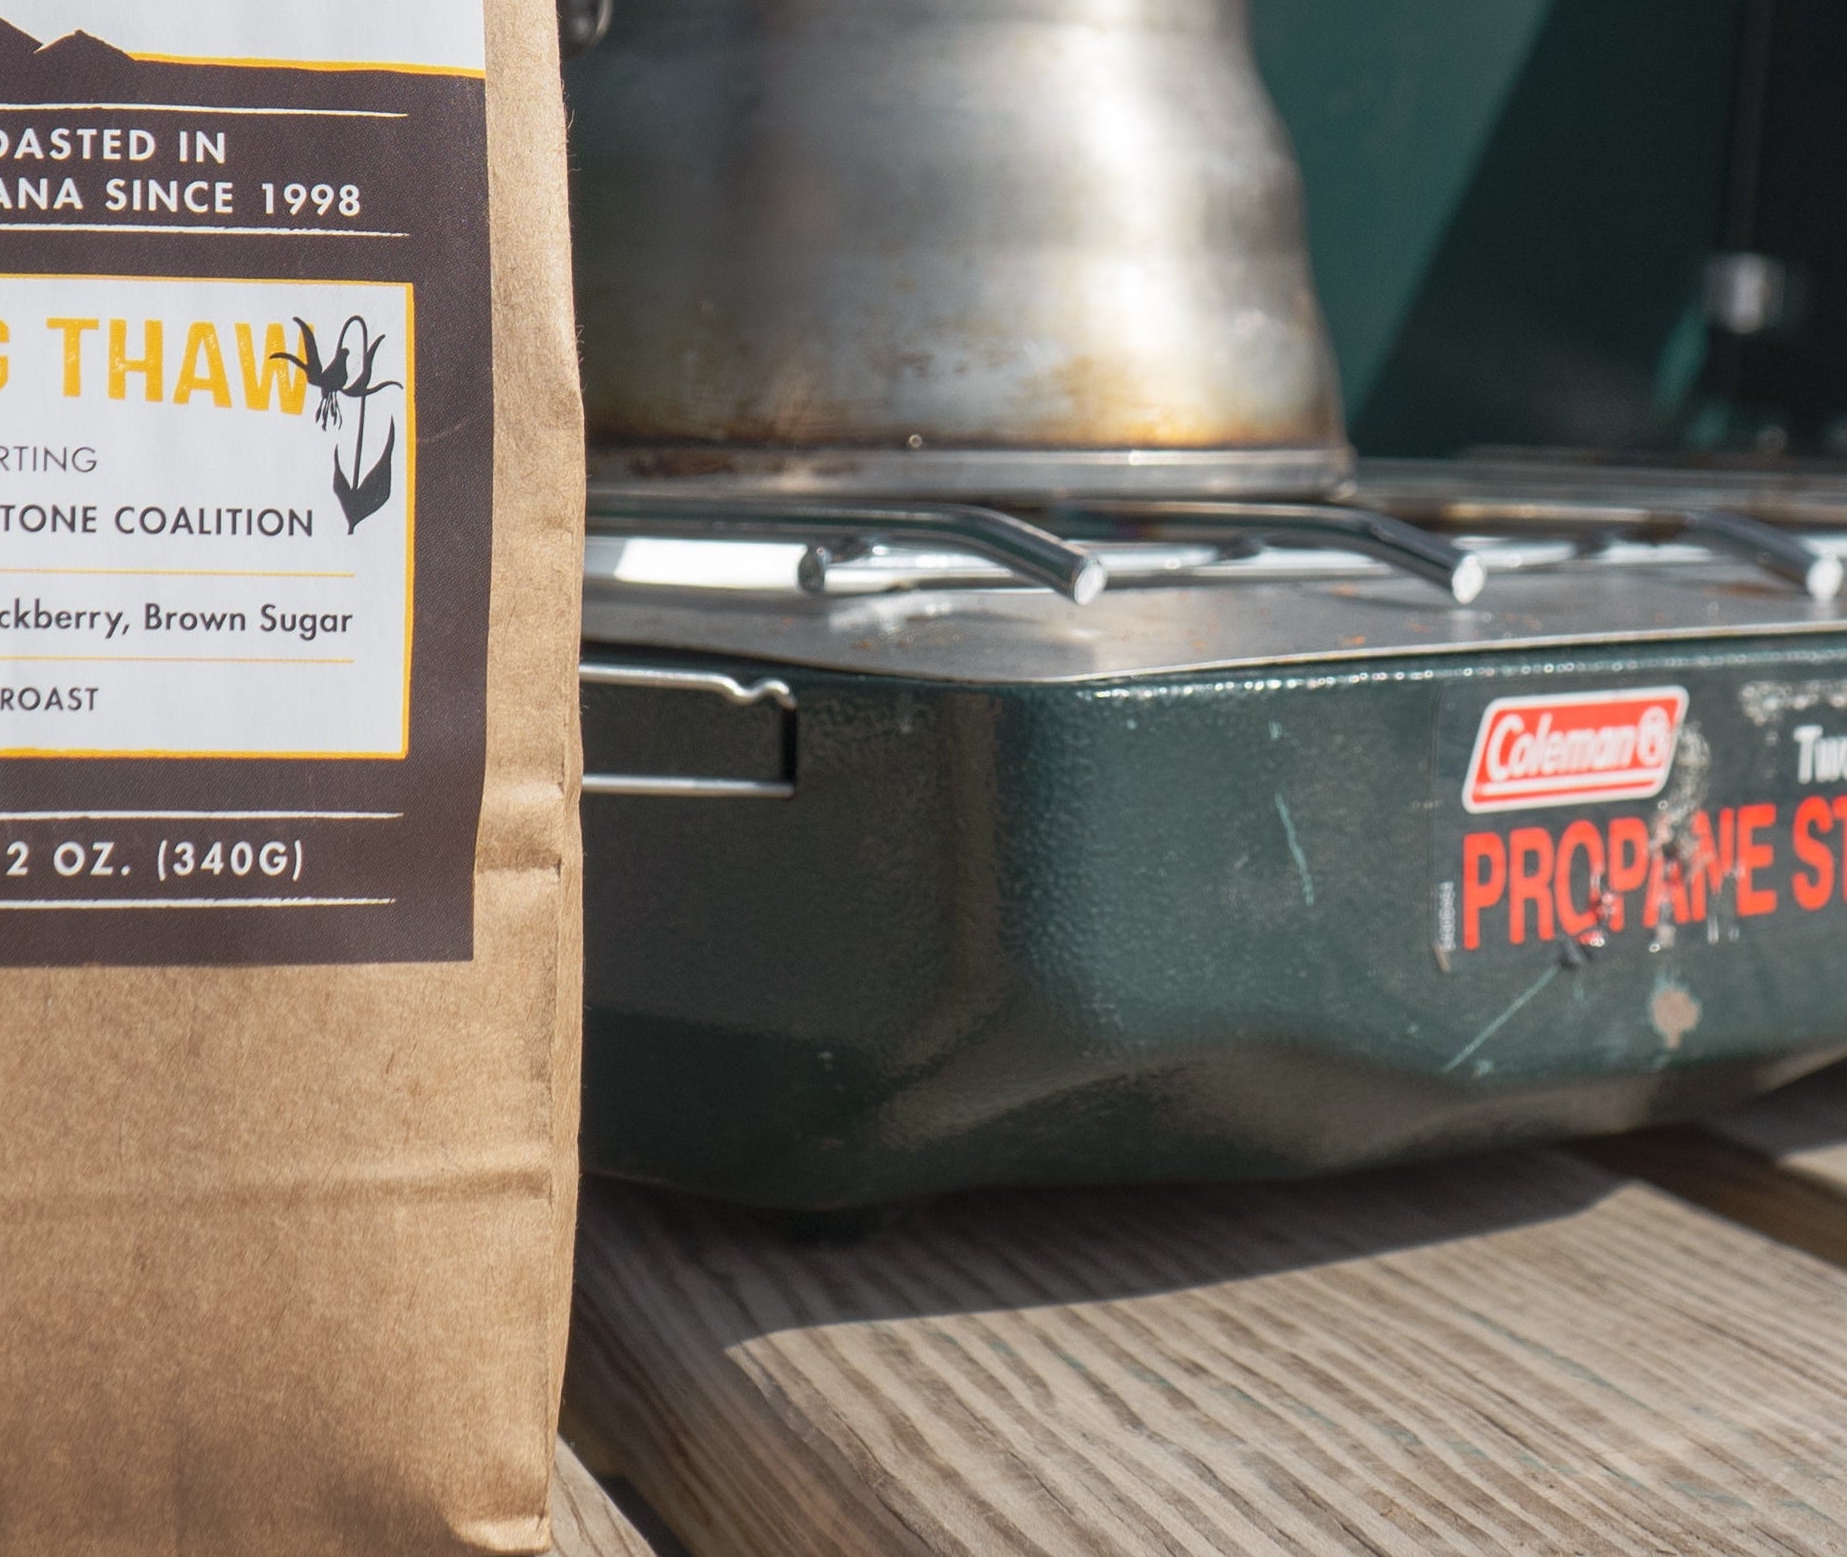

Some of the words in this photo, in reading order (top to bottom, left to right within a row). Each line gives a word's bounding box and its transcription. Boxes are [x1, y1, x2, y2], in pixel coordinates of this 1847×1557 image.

[178, 129, 227, 165] IN
[104, 177, 234, 215] SINCE
[260, 182, 362, 218] 1998
[45, 319, 316, 417] THAW
[113, 505, 314, 538] COALITION
[143, 601, 247, 632] Brown
[259, 602, 354, 643] Sugar
[0, 685, 100, 712] ROAST
[1485, 711, 1637, 782] Coleman
[52, 840, 132, 878] OZ.
[156, 838, 304, 883] (340G)
